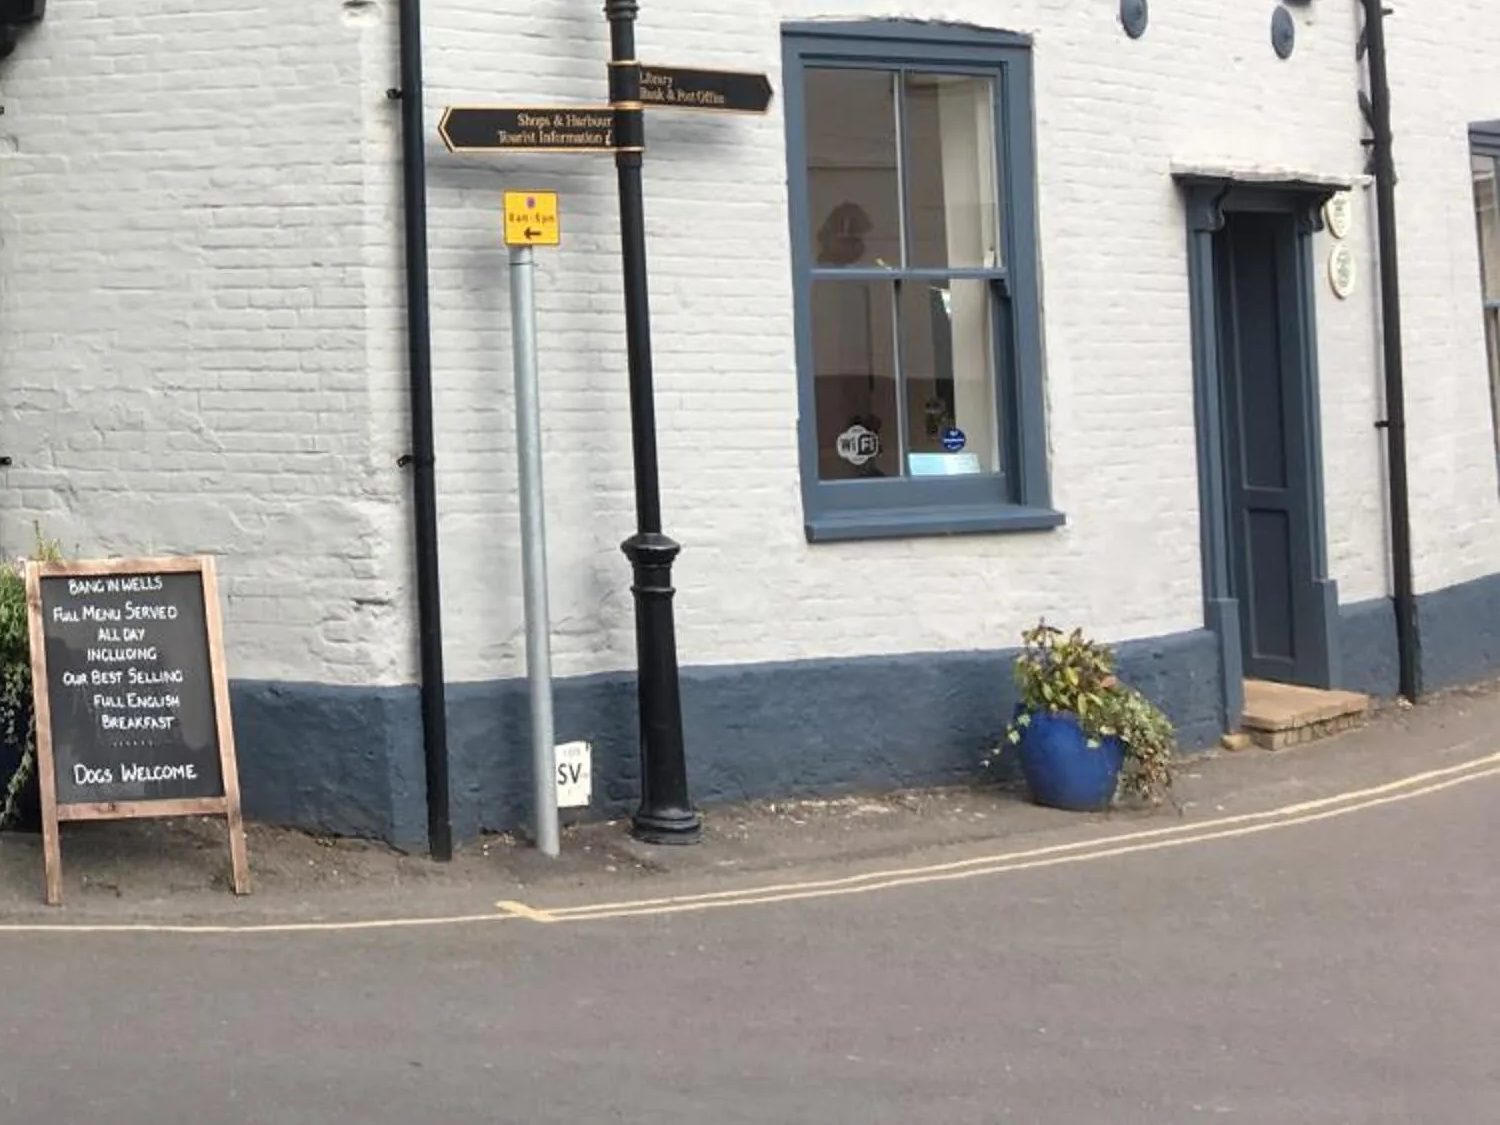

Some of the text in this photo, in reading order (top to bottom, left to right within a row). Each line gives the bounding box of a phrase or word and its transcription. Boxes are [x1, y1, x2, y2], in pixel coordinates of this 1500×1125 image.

[518, 113, 612, 130] Shops & Harbour
[497, 130, 535, 144] Tourist
[539, 131, 603, 144] Information
[68, 578, 105, 595] BANG
[121, 575, 163, 592] WELLS
[52, 600, 178, 623] FULL MENU SERVED
[98, 627, 145, 642] ALL DAY
[87, 646, 157, 662] INCLUDING
[63, 666, 183, 686] OUR BEST SELLING
[93, 691, 181, 708] FULL ENGLISH
[101, 713, 176, 730] BREAKFAST
[73, 762, 198, 785] DOGS WELCOME
[557, 762, 583, 786] SV
